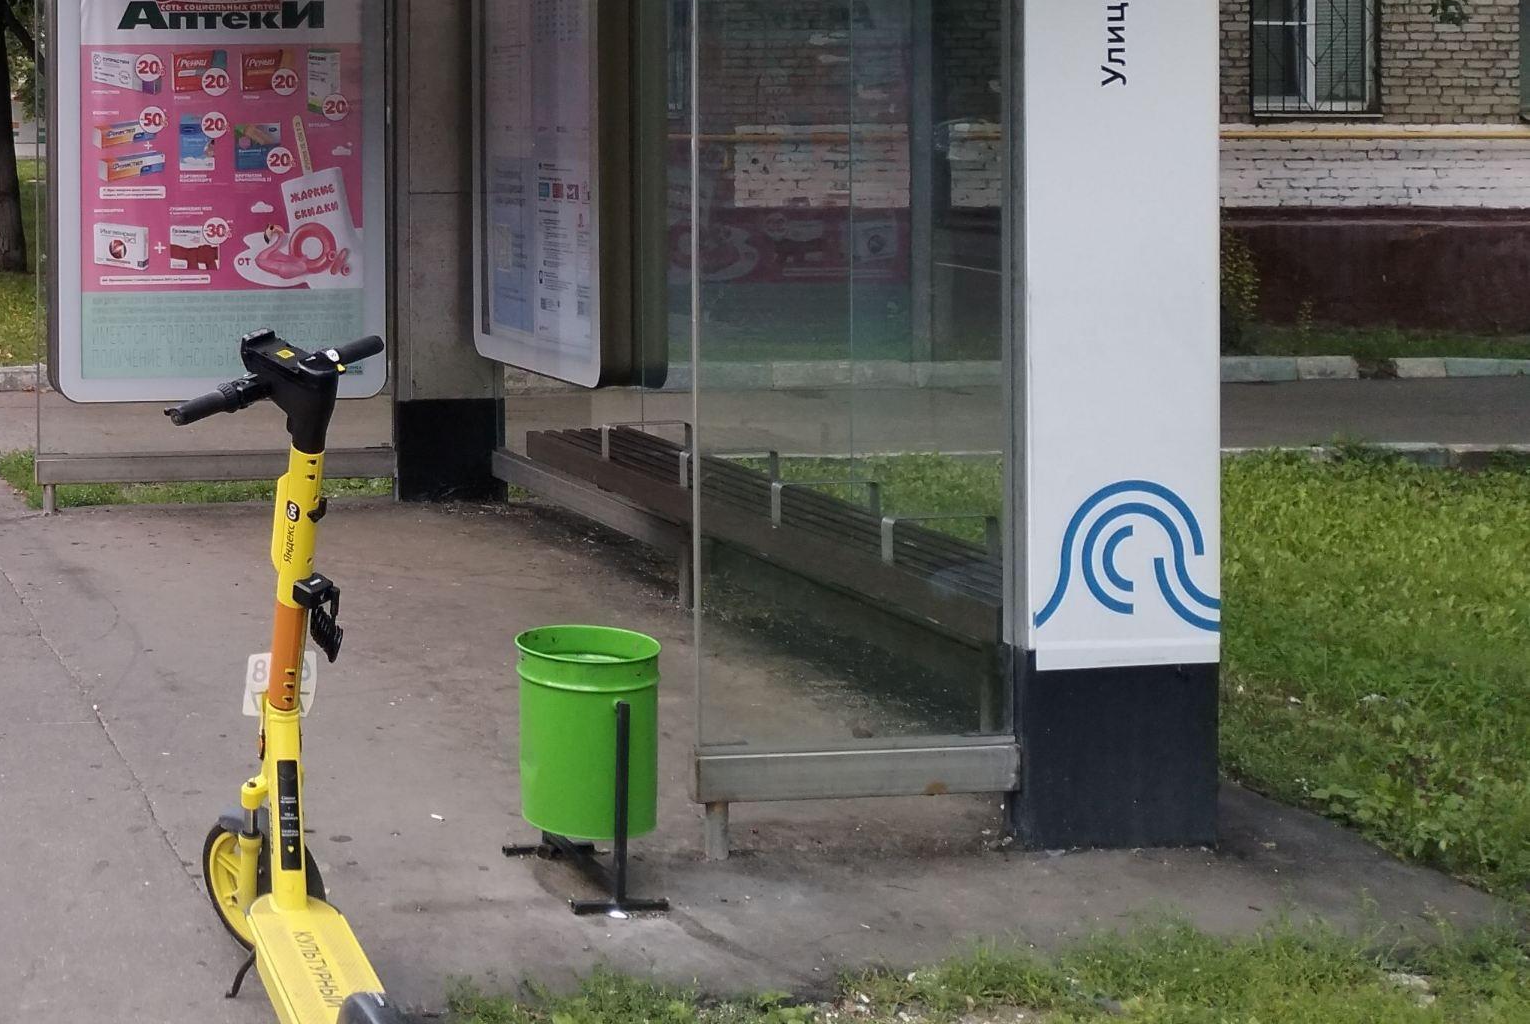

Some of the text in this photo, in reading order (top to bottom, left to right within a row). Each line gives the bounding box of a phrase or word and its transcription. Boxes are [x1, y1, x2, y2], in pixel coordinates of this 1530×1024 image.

[290, 184, 335, 203] ЖАРКИЕ
[294, 201, 339, 220] СКИДКИ
[237, 257, 251, 266] ОТ
[283, 503, 298, 564] Яндекс Go
